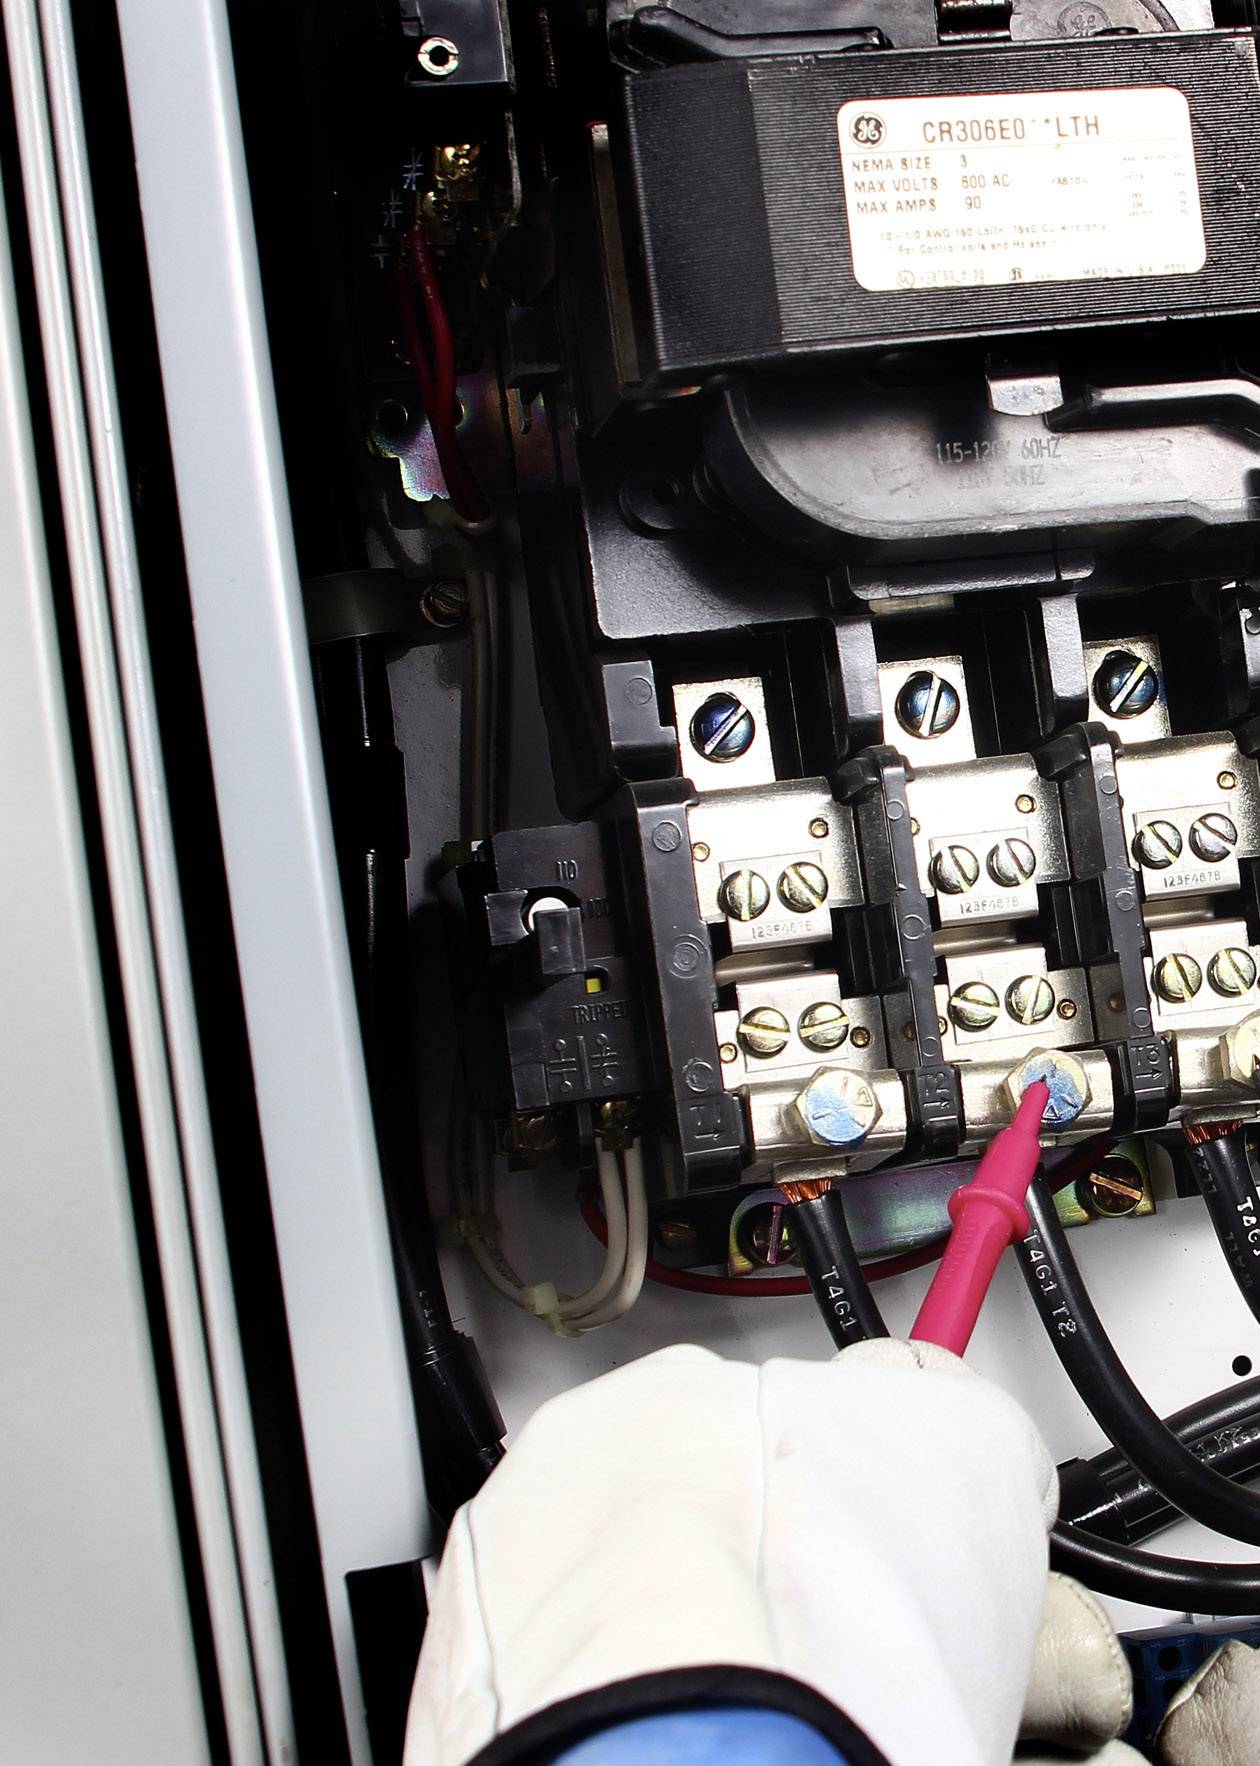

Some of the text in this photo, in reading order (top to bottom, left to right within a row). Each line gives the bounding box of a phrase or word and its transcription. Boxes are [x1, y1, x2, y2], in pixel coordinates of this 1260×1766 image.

[852, 153, 968, 172] NEMA SIZE 3
[854, 180, 886, 194] MAX
[892, 177, 939, 192] VOLTS
[992, 173, 1011, 187] AC
[856, 195, 982, 214] MAX AMPS 90
[1020, 435, 1062, 460] 60HZ
[1130, 1044, 1161, 1066] T3
[1022, 1228, 1058, 1297] T4G1
[820, 1264, 858, 1332] T4G1
